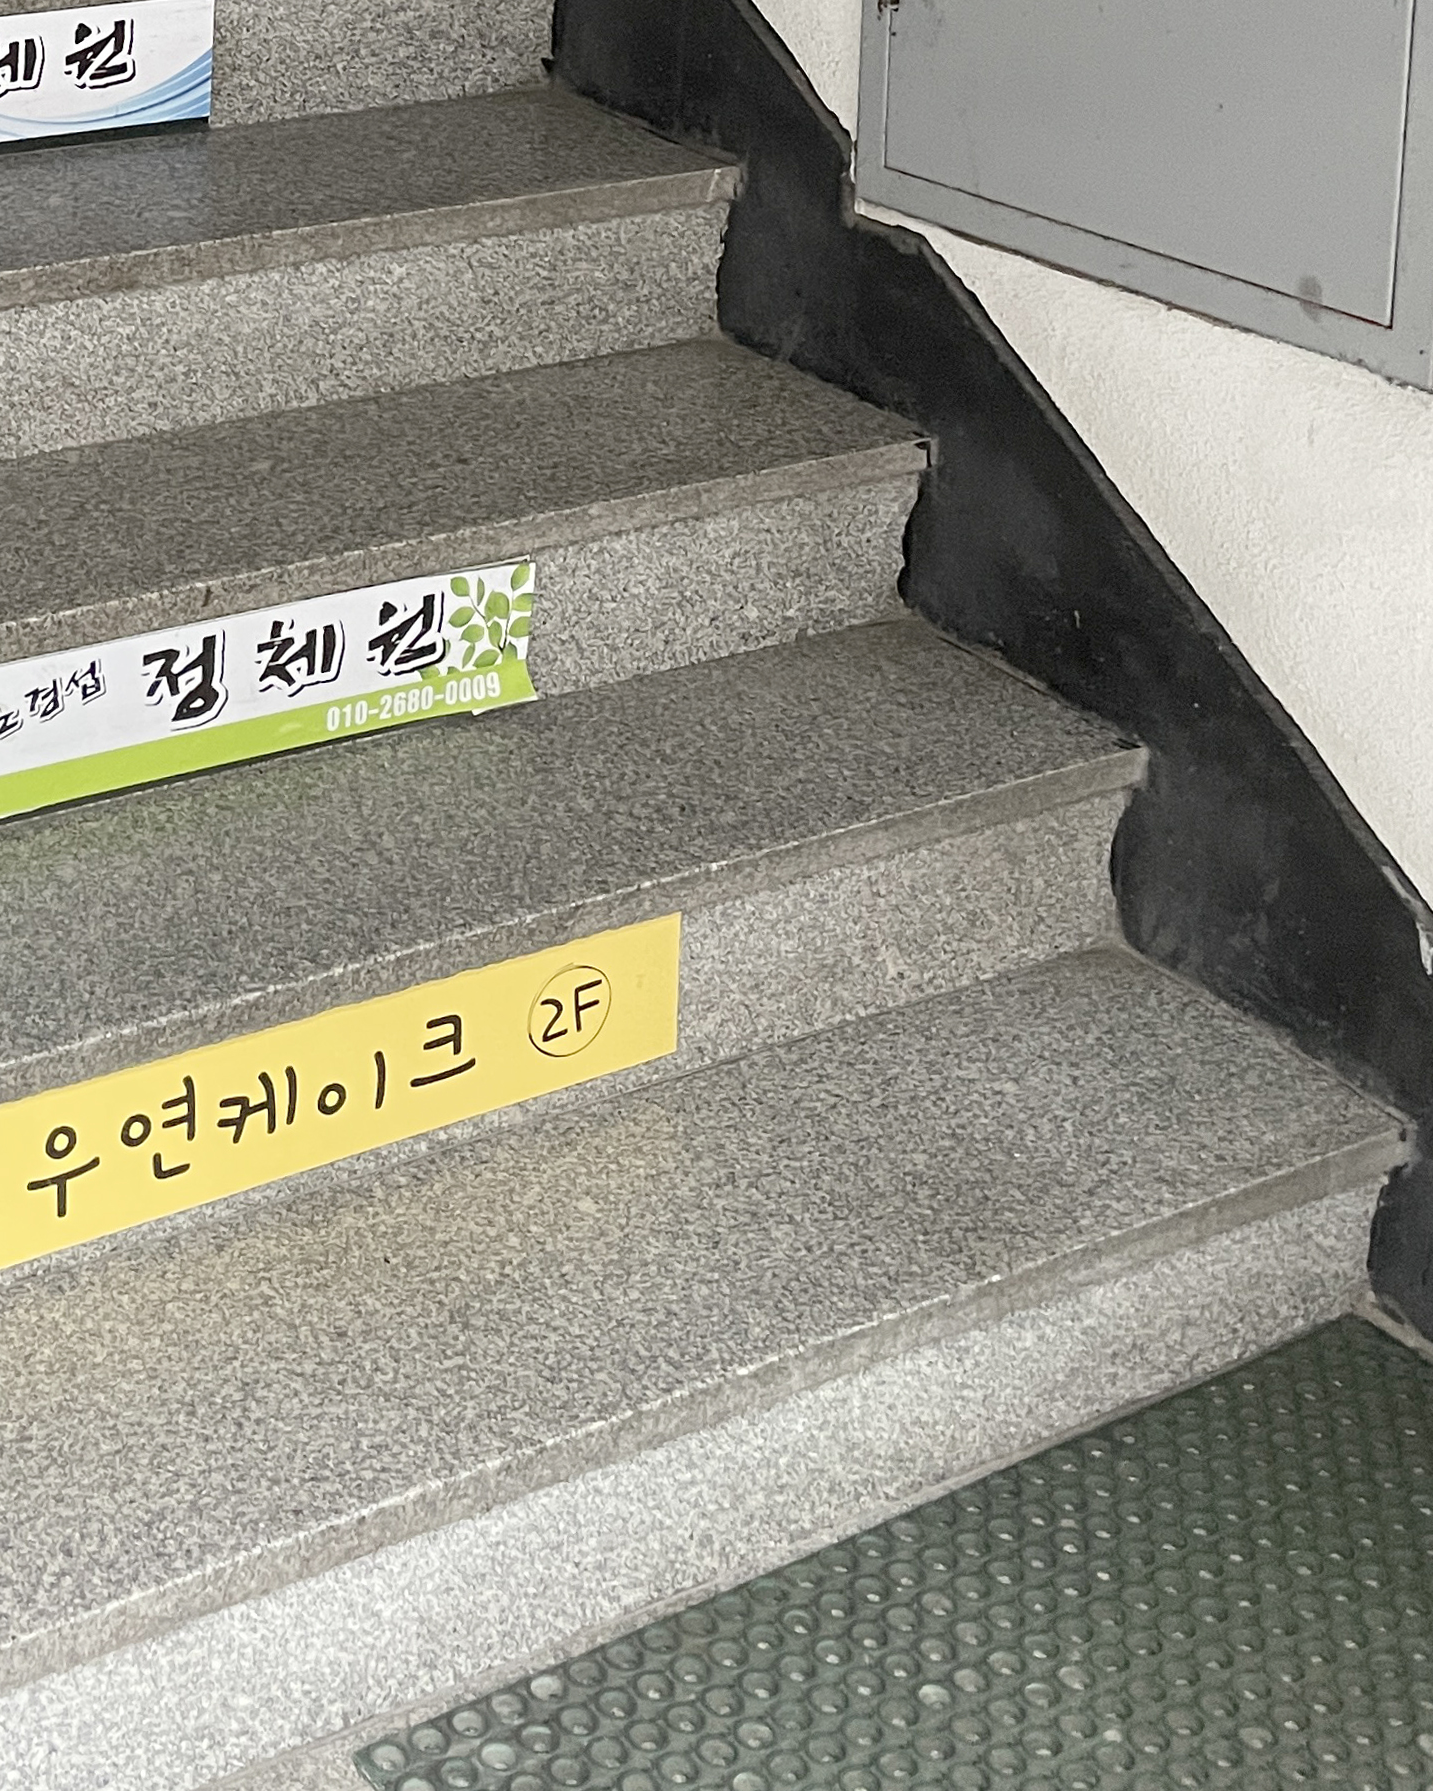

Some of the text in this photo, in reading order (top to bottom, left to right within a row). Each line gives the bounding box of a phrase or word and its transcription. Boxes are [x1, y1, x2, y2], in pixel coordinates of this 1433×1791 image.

[325, 673, 502, 732] 010-2680-0009
[26, 974, 607, 1218] 우연케이크 2F
